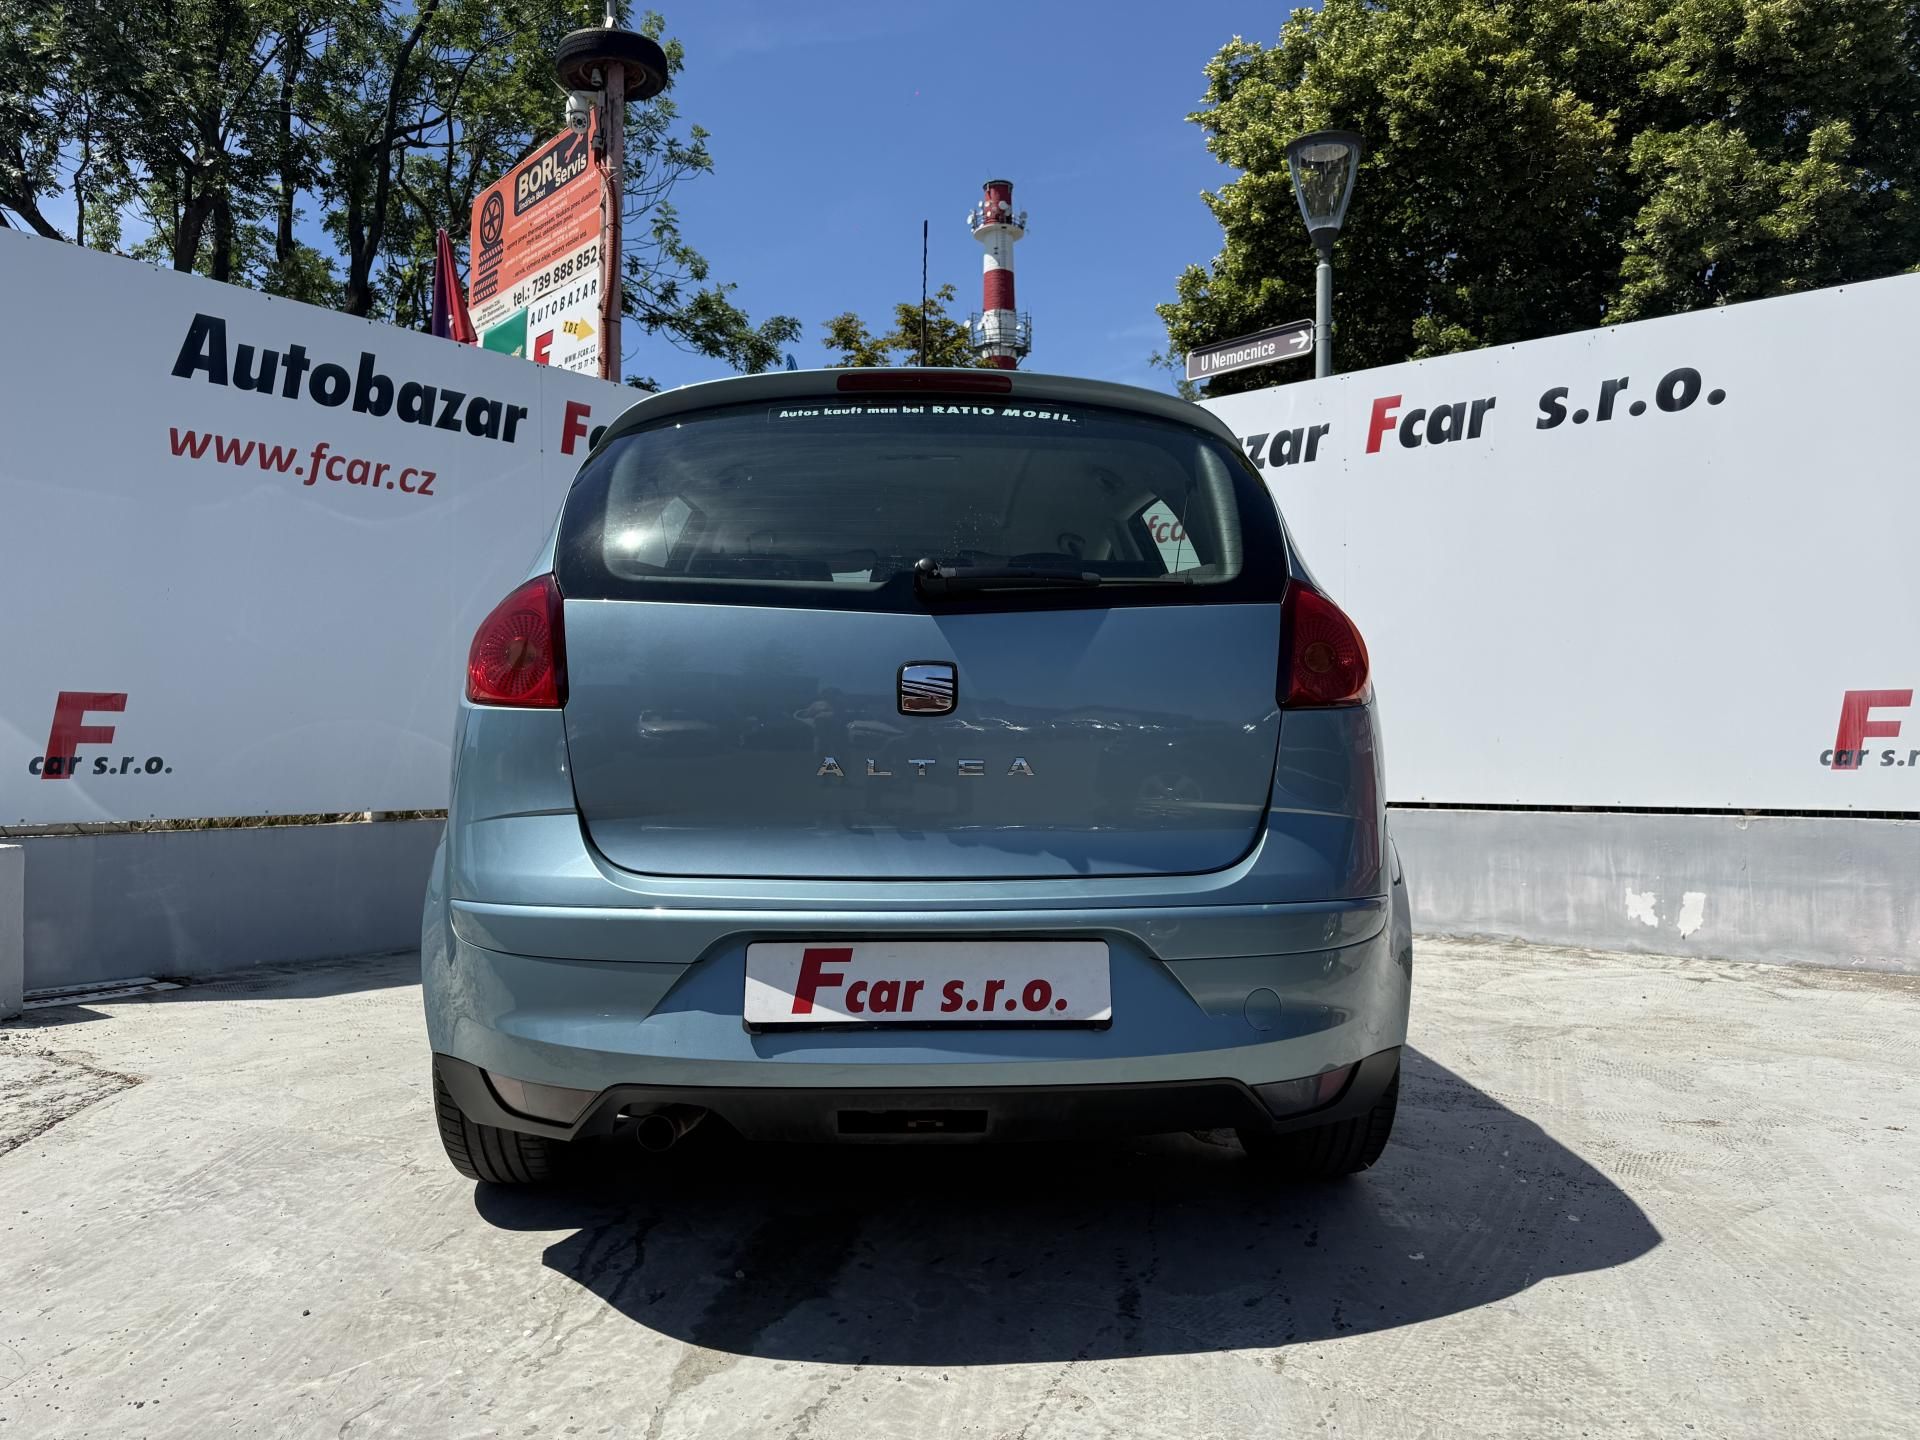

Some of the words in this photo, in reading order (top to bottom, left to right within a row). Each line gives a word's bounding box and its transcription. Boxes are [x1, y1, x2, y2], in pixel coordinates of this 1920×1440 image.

[555, 153, 586, 187] servis
[513, 286, 530, 307] tel.:
[532, 272, 550, 296] 739
[553, 259, 573, 283] 888
[576, 245, 597, 271] 852
[530, 279, 597, 327] AUTOBAZAR
[563, 321, 579, 335] ZDE
[1201, 355, 1209, 371] U
[1211, 341, 1276, 370] Nemocnice
[171, 313, 527, 443] Autobazar
[779, 408, 819, 418] Autos
[823, 406, 862, 415] kauft
[867, 406, 898, 414] man
[902, 405, 924, 414] bei
[932, 406, 995, 415] RATIO
[1001, 408, 1078, 422] MOBIL.
[1237, 422, 1330, 469] zar
[1366, 394, 1496, 454] Fcar
[1536, 367, 1727, 429] s.r.o.
[169, 427, 437, 496] www.fcar.cz
[92, 756, 173, 775] s.r.o.
[816, 757, 1035, 777] ALTEA
[791, 947, 924, 1015] Fcar
[940, 978, 1068, 1013] s.r.o.
